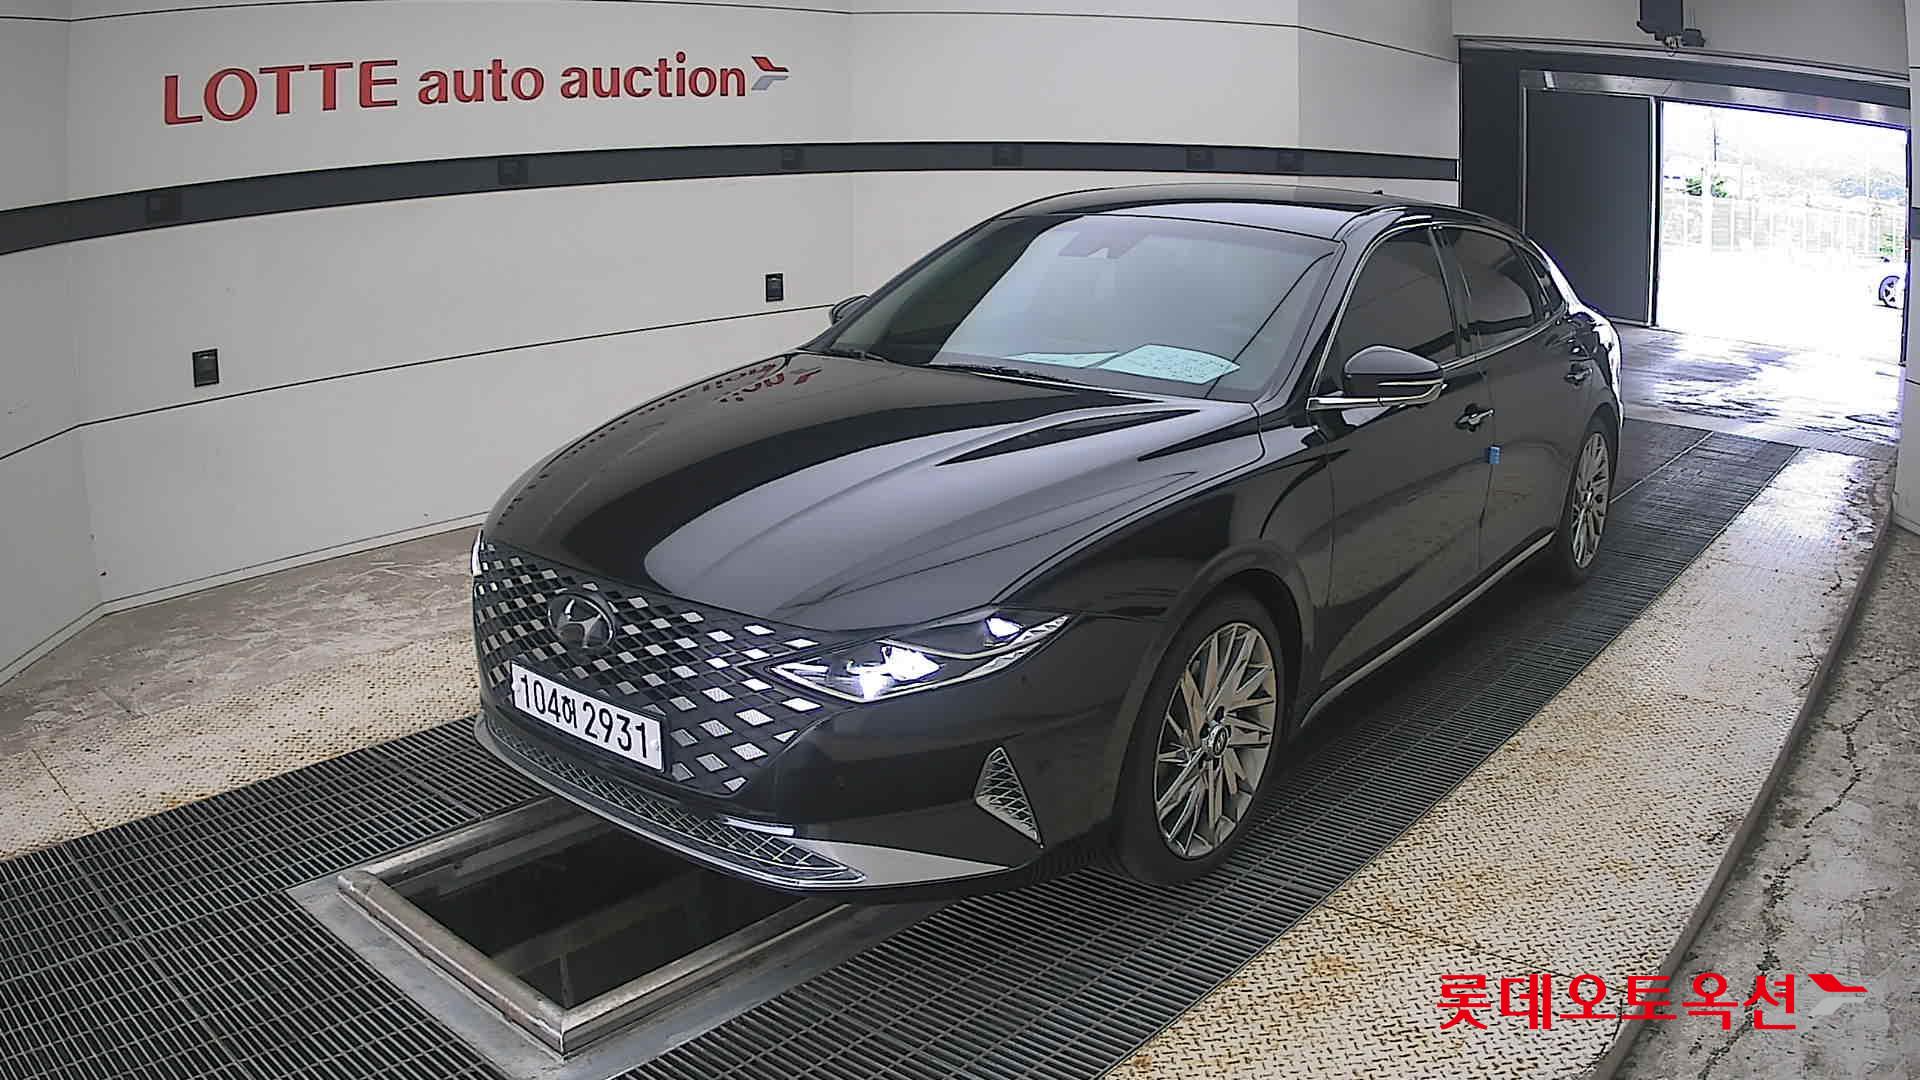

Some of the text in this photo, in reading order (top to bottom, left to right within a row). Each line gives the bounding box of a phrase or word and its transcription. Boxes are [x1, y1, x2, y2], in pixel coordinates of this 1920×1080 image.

[163, 51, 747, 126] LOTTE auto auction
[520, 673, 649, 759] 104허 2931
